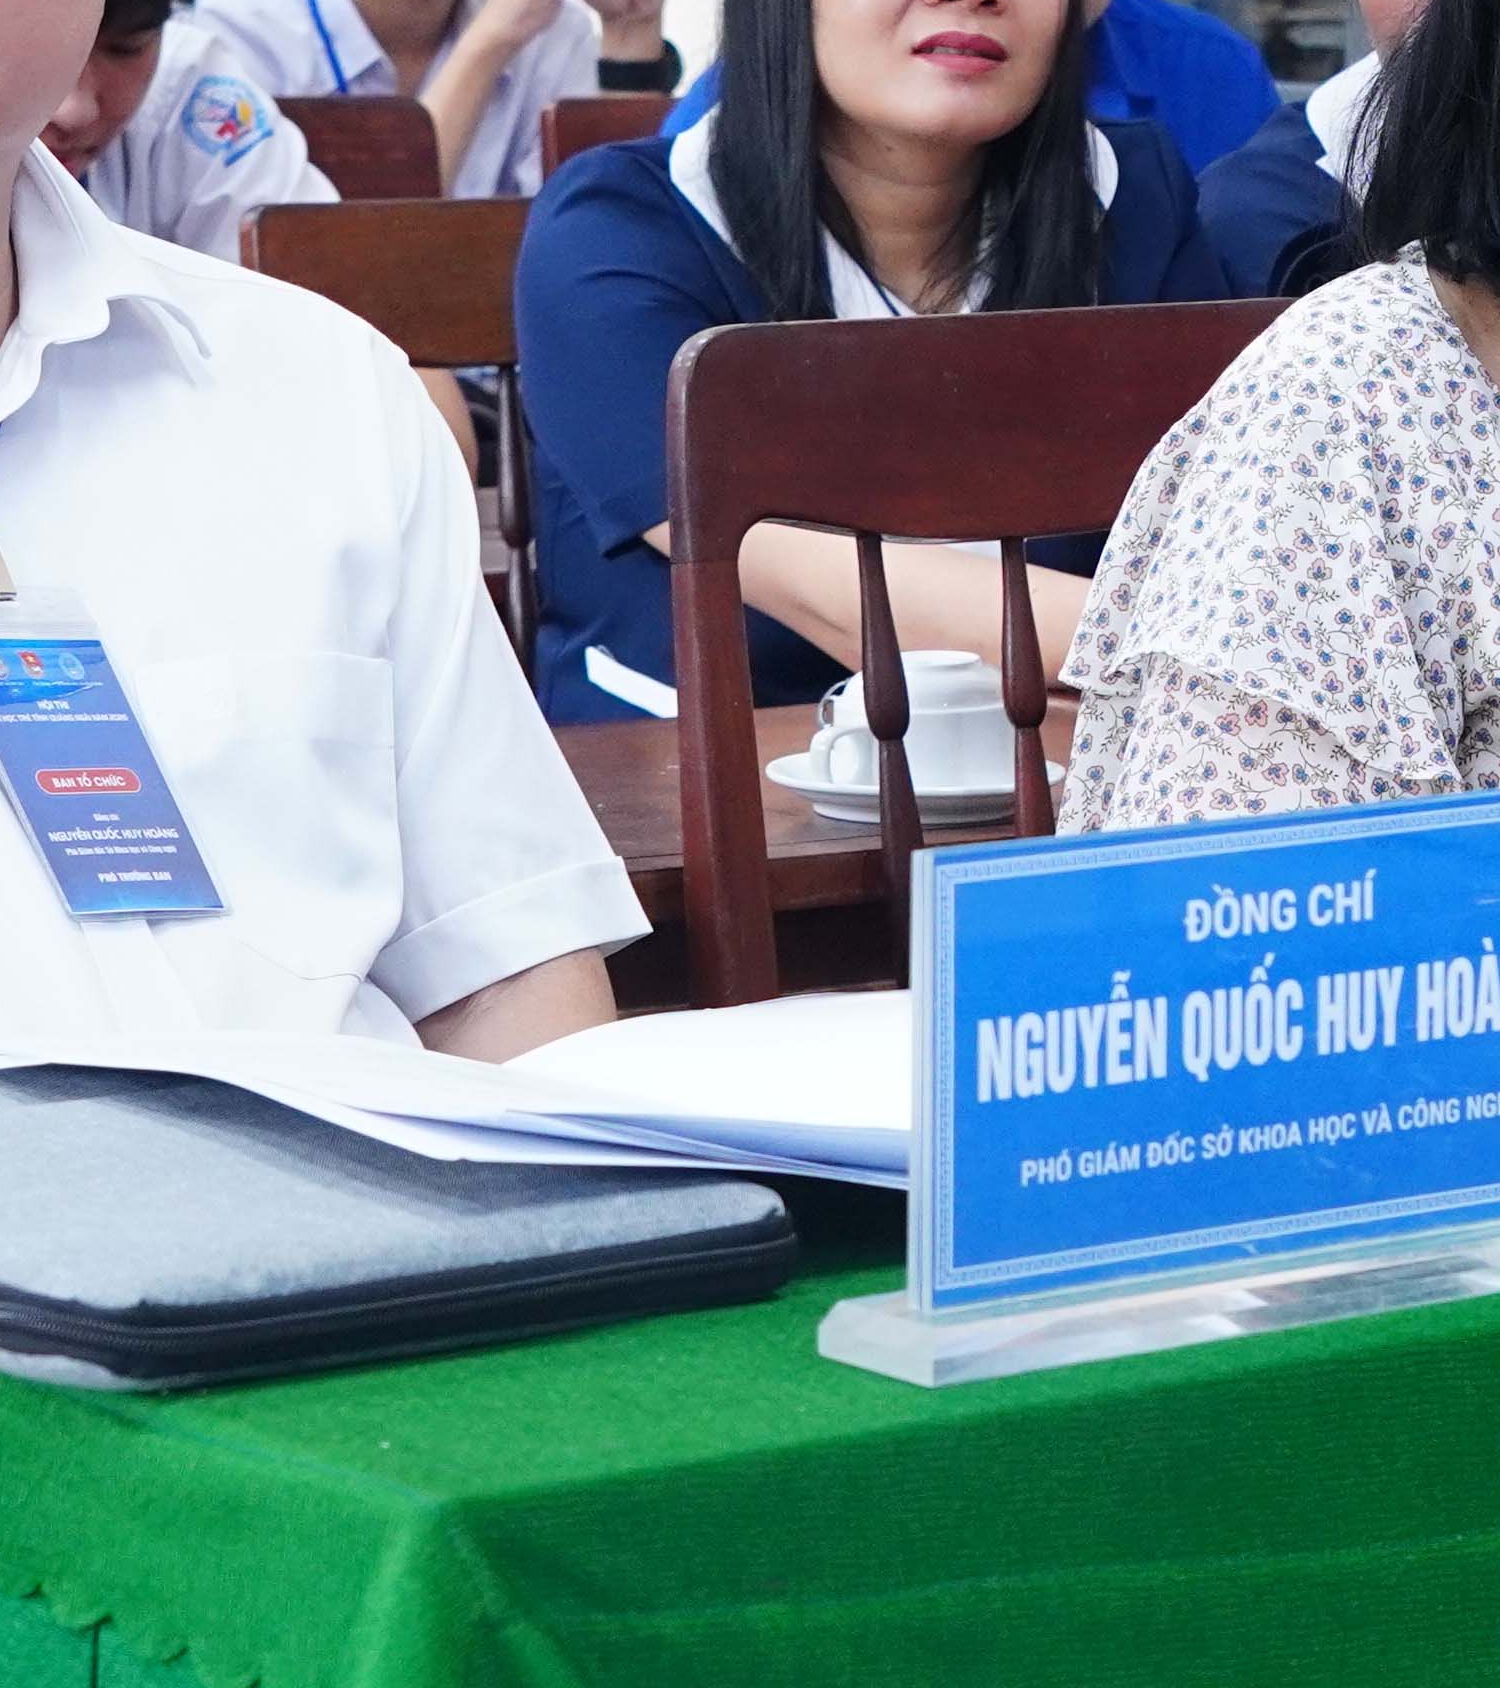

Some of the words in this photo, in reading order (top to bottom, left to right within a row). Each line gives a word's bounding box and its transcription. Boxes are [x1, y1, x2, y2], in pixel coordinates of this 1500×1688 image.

[52, 777, 76, 788] BAN
[1184, 884, 1296, 942] ĐỒNG
[1308, 868, 1376, 927] CHÍ
[977, 970, 1167, 1103] NGUYỄN
[1182, 951, 1304, 1083] QUỐC
[1316, 965, 1404, 1056] HUY
[1021, 1149, 1072, 1187] PHÓ
[1077, 1142, 1140, 1178] GIÁM
[1146, 1132, 1195, 1168] ĐỐC
[1201, 1123, 1234, 1160] SỞ
[1238, 1121, 1302, 1154] KHOA
[1308, 1112, 1356, 1146] HỌC
[1362, 1102, 1392, 1136] VÀ
[1398, 1097, 1460, 1130] CÔNG
